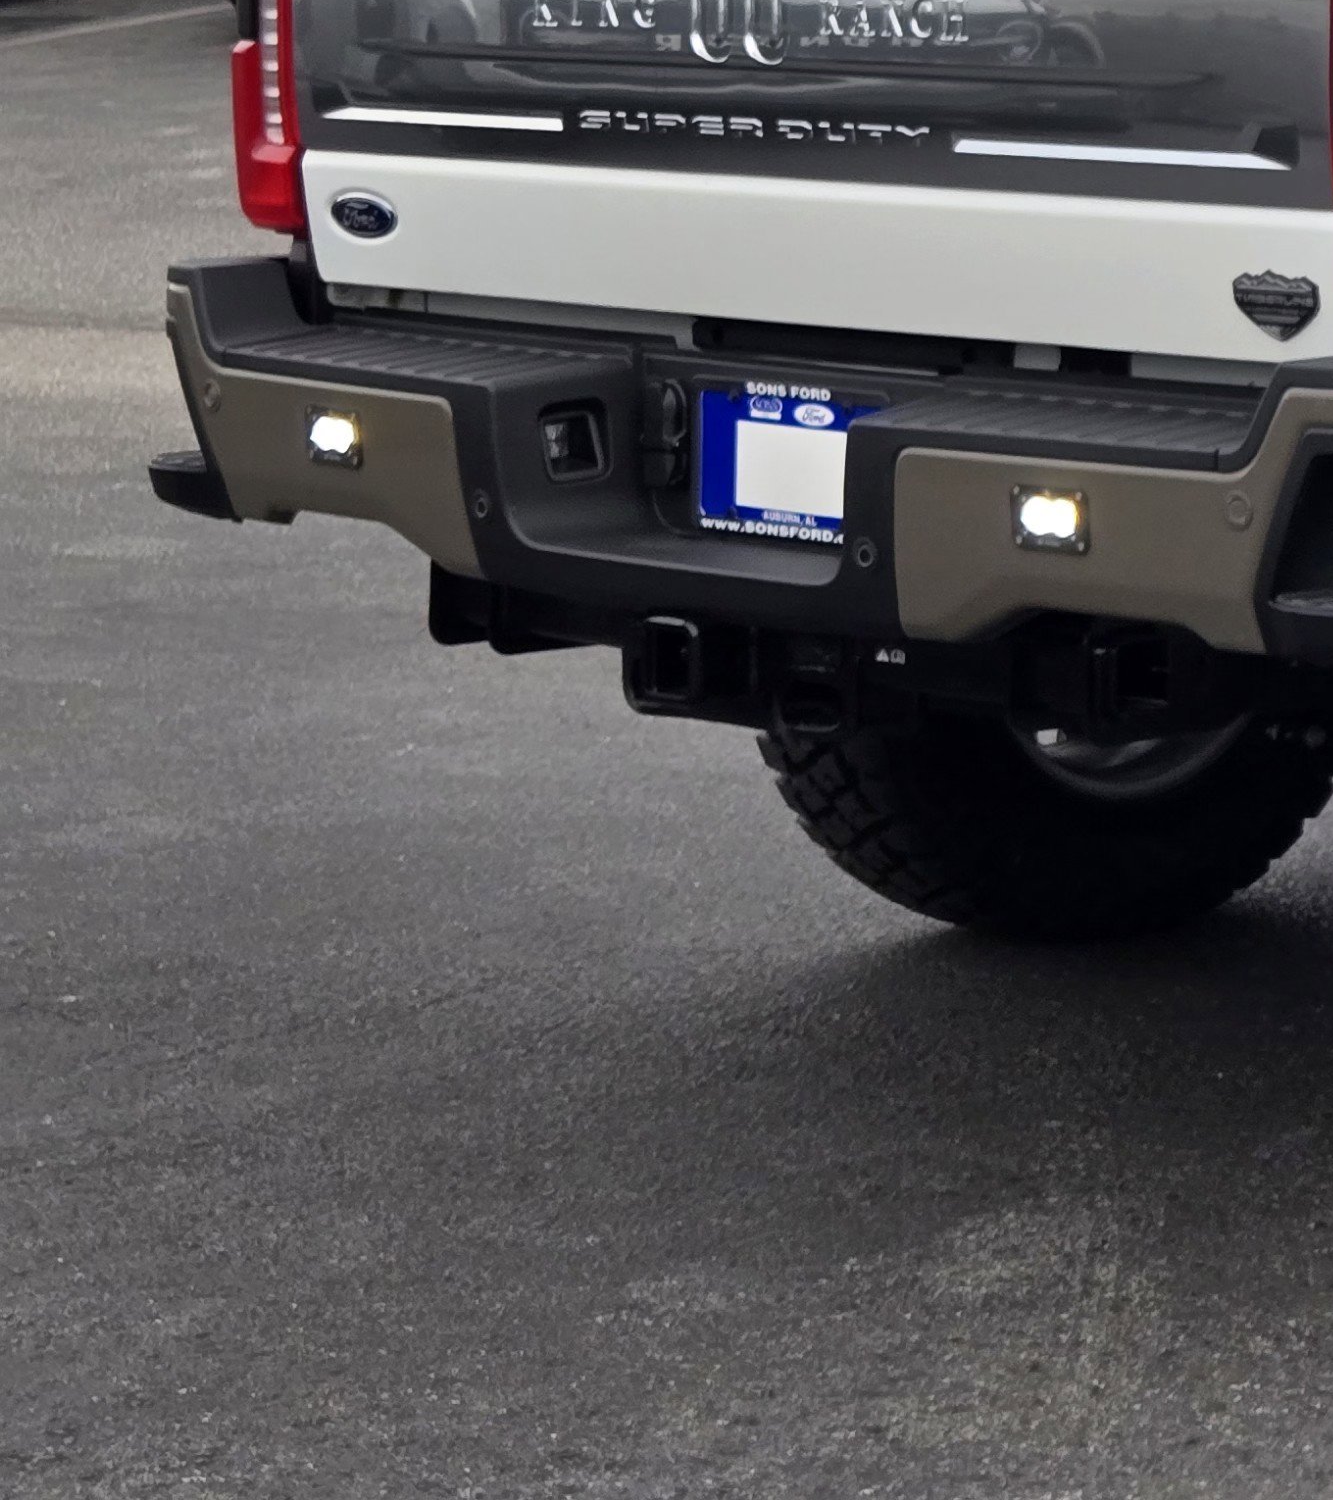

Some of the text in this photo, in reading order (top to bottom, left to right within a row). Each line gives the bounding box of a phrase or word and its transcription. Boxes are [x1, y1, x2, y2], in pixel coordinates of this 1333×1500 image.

[579, 109, 931, 146] SUPER DUTY
[746, 381, 832, 402] SONS FORD
